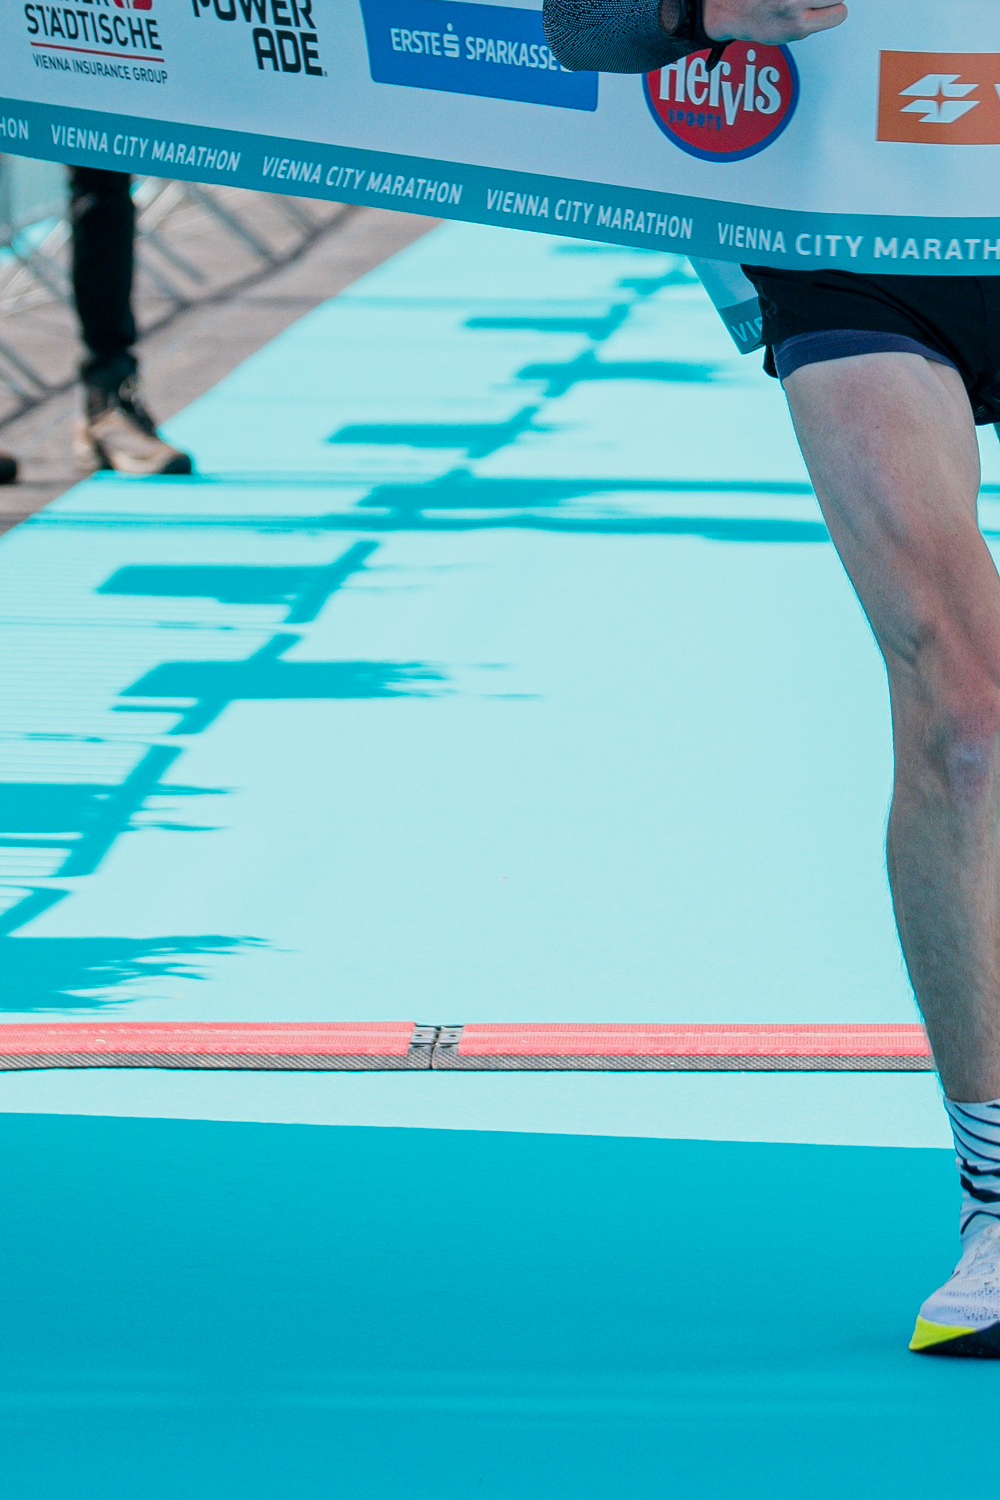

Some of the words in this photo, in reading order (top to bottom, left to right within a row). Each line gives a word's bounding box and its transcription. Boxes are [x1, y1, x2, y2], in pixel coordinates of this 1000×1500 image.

[25, 3, 163, 51] STÄDTISCHE
[390, 27, 442, 56] ERSTE
[32, 53, 71, 72] VIENNA
[72, 59, 132, 80] INSURANCE
[132, 67, 168, 84] GROUP
[252, 27, 323, 77] ADE
[658, 48, 782, 126] Hervis
[668, 108, 723, 130] SPORTS
[50, 123, 109, 153] VIENNA
[113, 134, 150, 159] CITY
[151, 139, 242, 172] MARATHON
[262, 155, 323, 184] VIENNA
[325, 165, 366, 190] CITY
[365, 171, 464, 205] MARATHON
[486, 188, 549, 218] VIENNA
[554, 198, 595, 225] CITY
[596, 204, 694, 240] MARATHON
[717, 222, 787, 254] VIENNA
[794, 233, 865, 258] CITY
